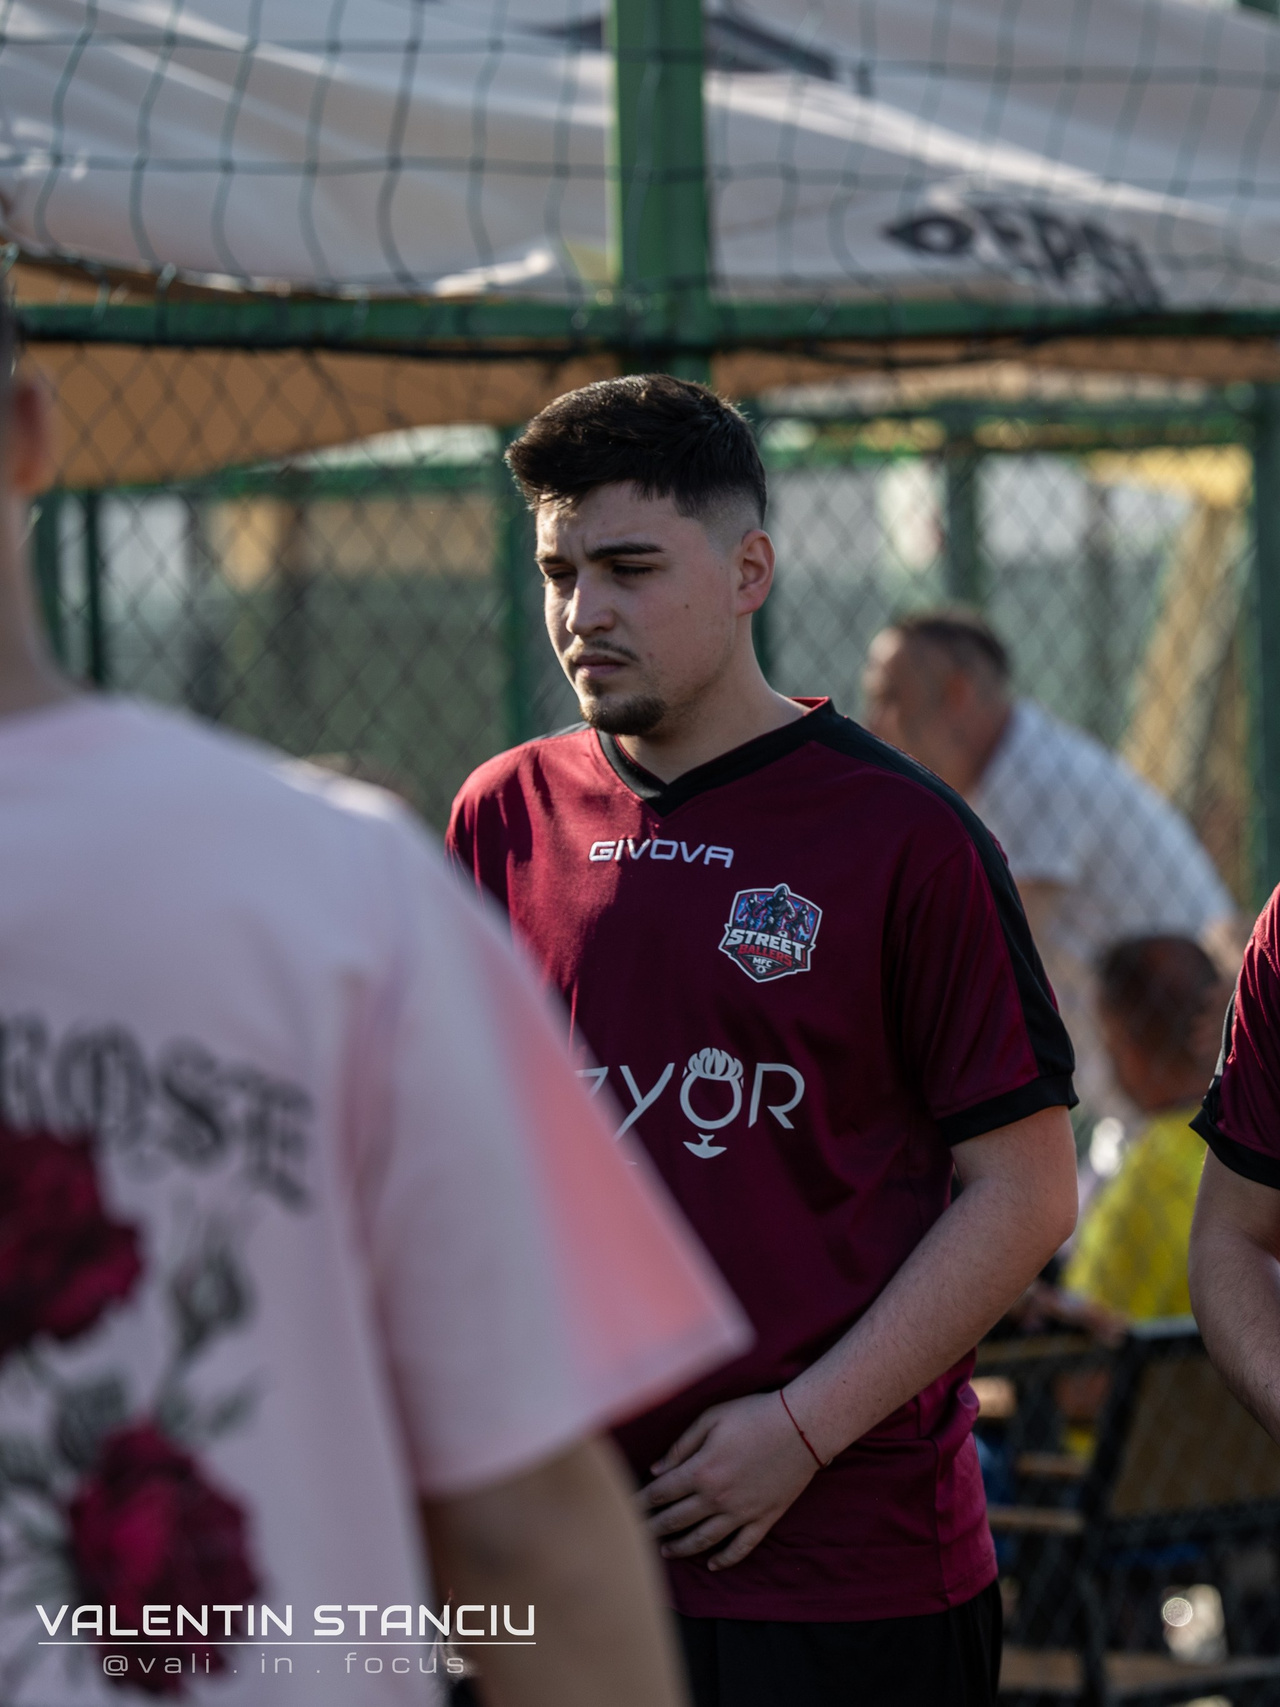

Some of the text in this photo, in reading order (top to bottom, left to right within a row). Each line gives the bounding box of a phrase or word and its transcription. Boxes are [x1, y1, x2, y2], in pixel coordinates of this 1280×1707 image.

[588, 838, 735, 869] GIVOVA
[726, 928, 806, 961] STREET
[737, 944, 794, 967] BALLERS
[752, 957, 773, 968] MFC
